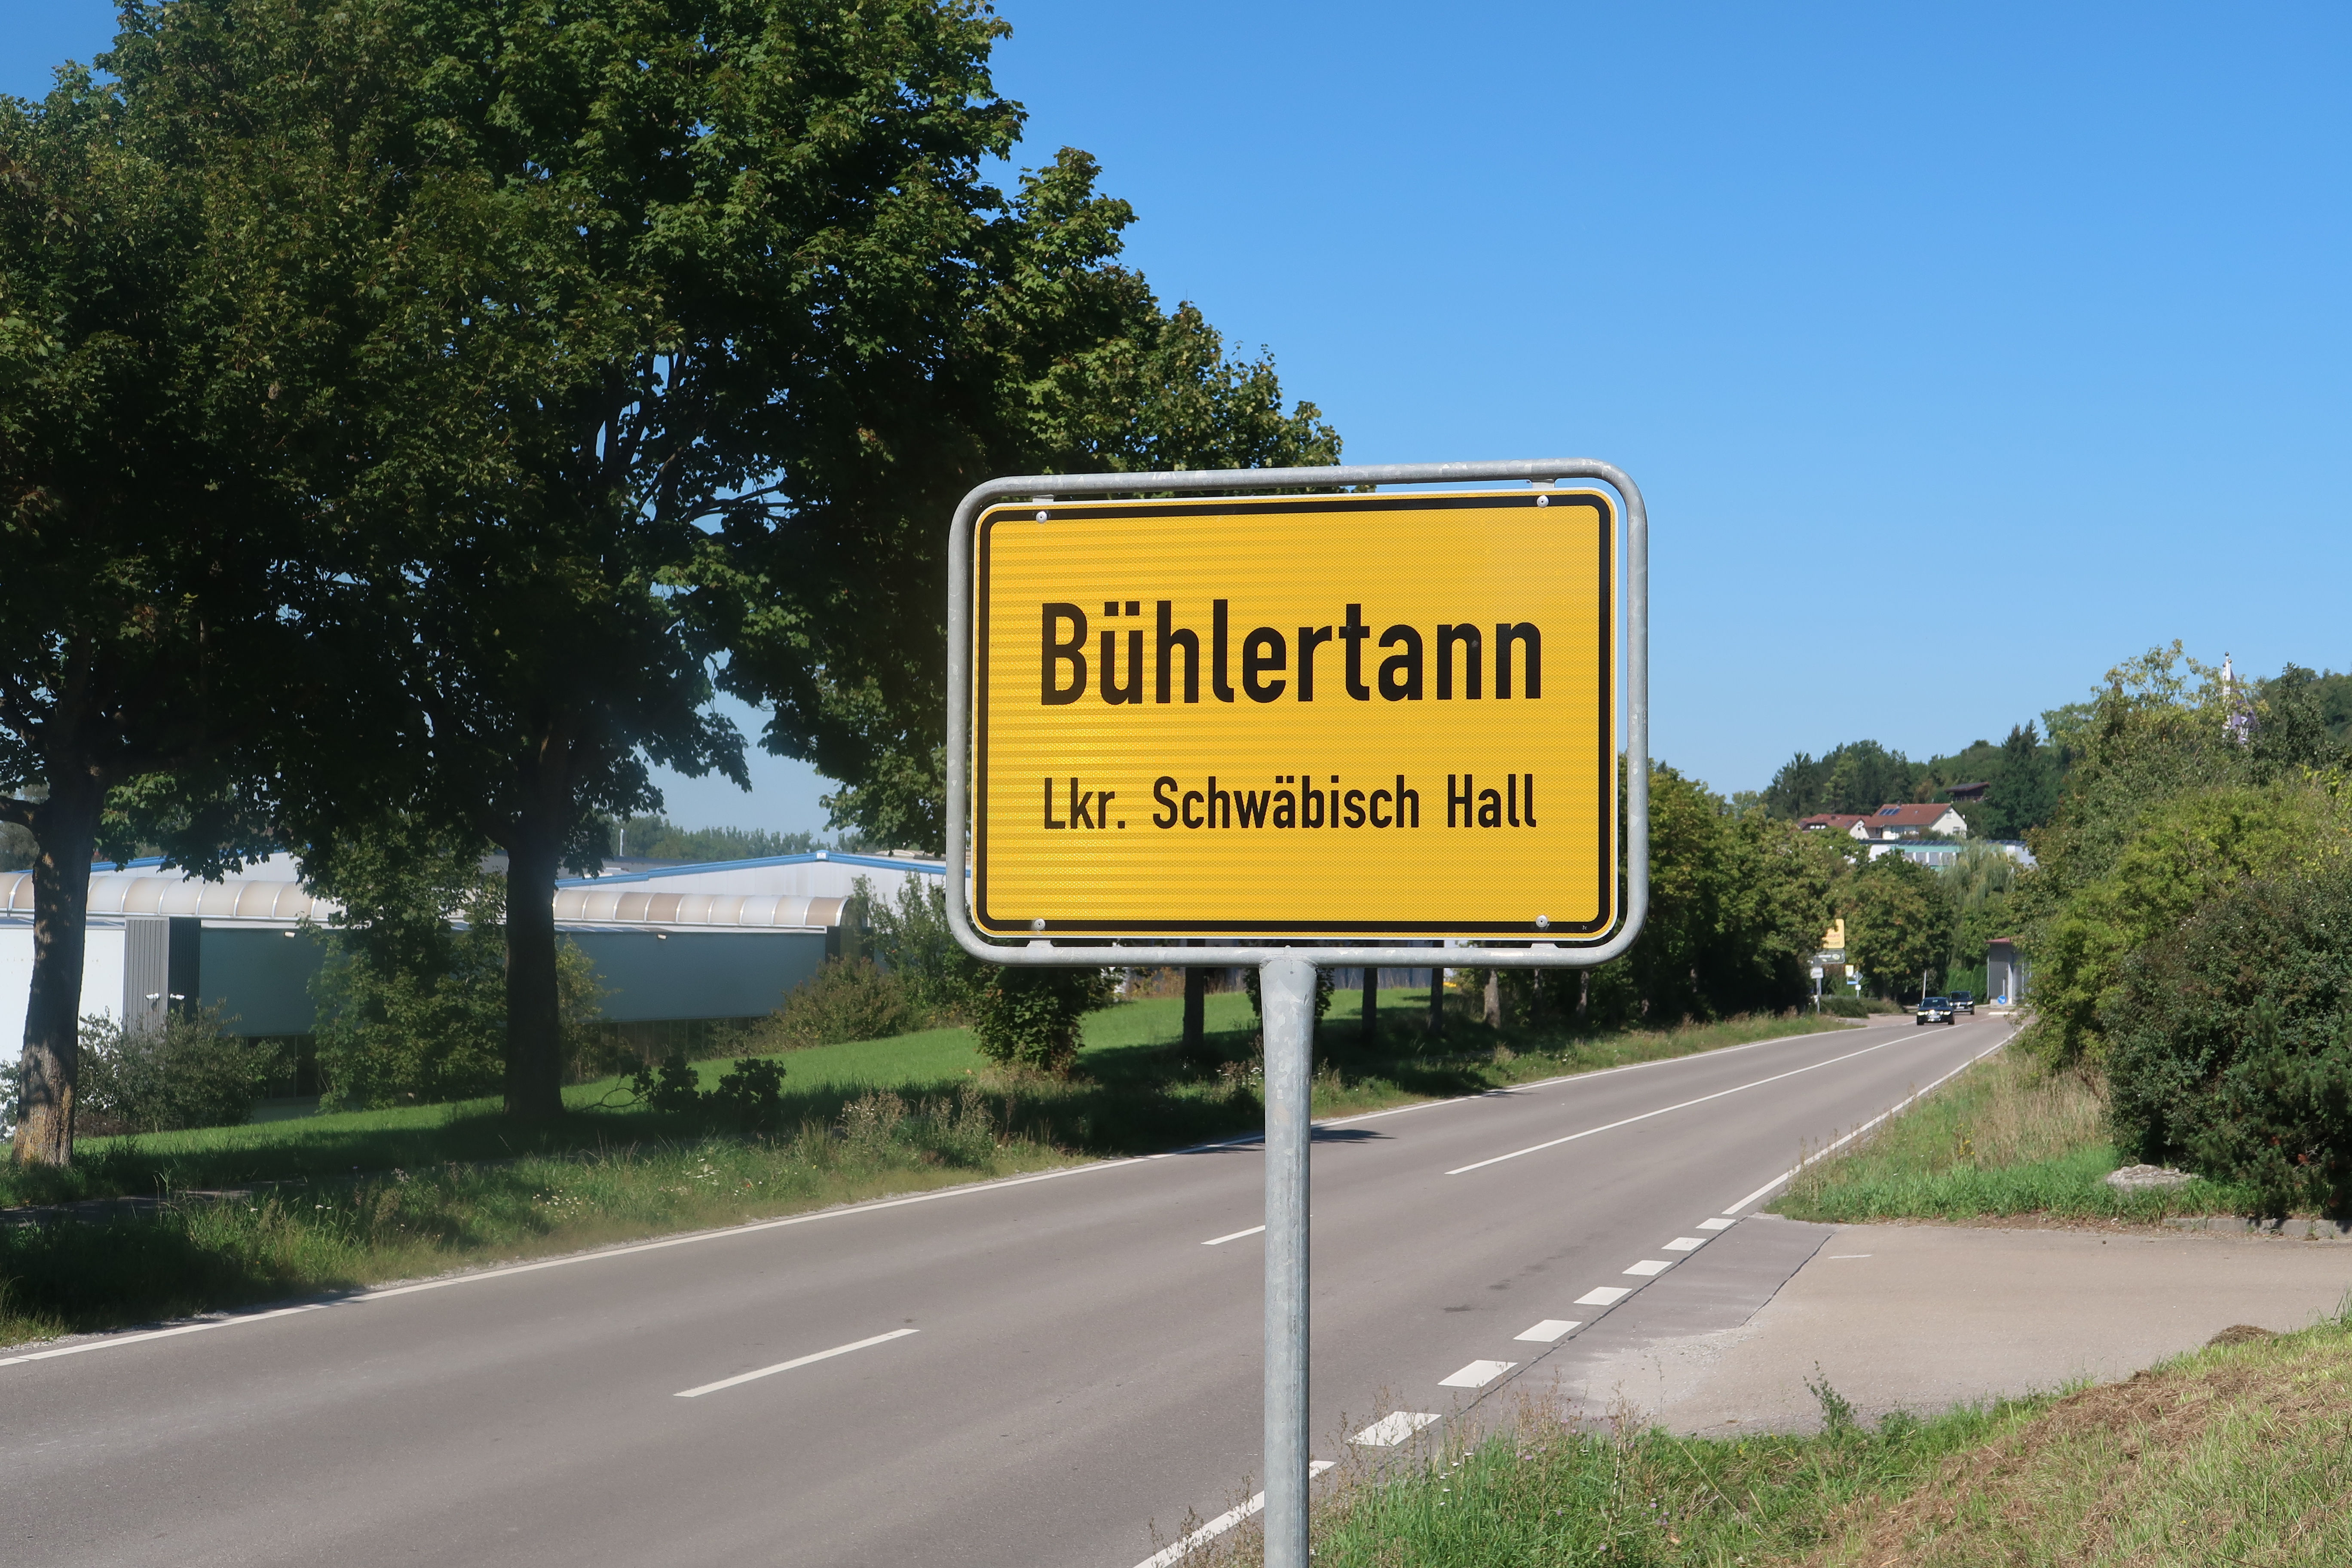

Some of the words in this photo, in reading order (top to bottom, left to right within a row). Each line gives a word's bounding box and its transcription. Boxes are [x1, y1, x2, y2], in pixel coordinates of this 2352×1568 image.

[1041, 599, 1541, 705] Bühlertann
[1044, 777, 1125, 829] Lkr.
[1153, 775, 1419, 829] Schwäbisch
[1448, 774, 1536, 828] Hall
